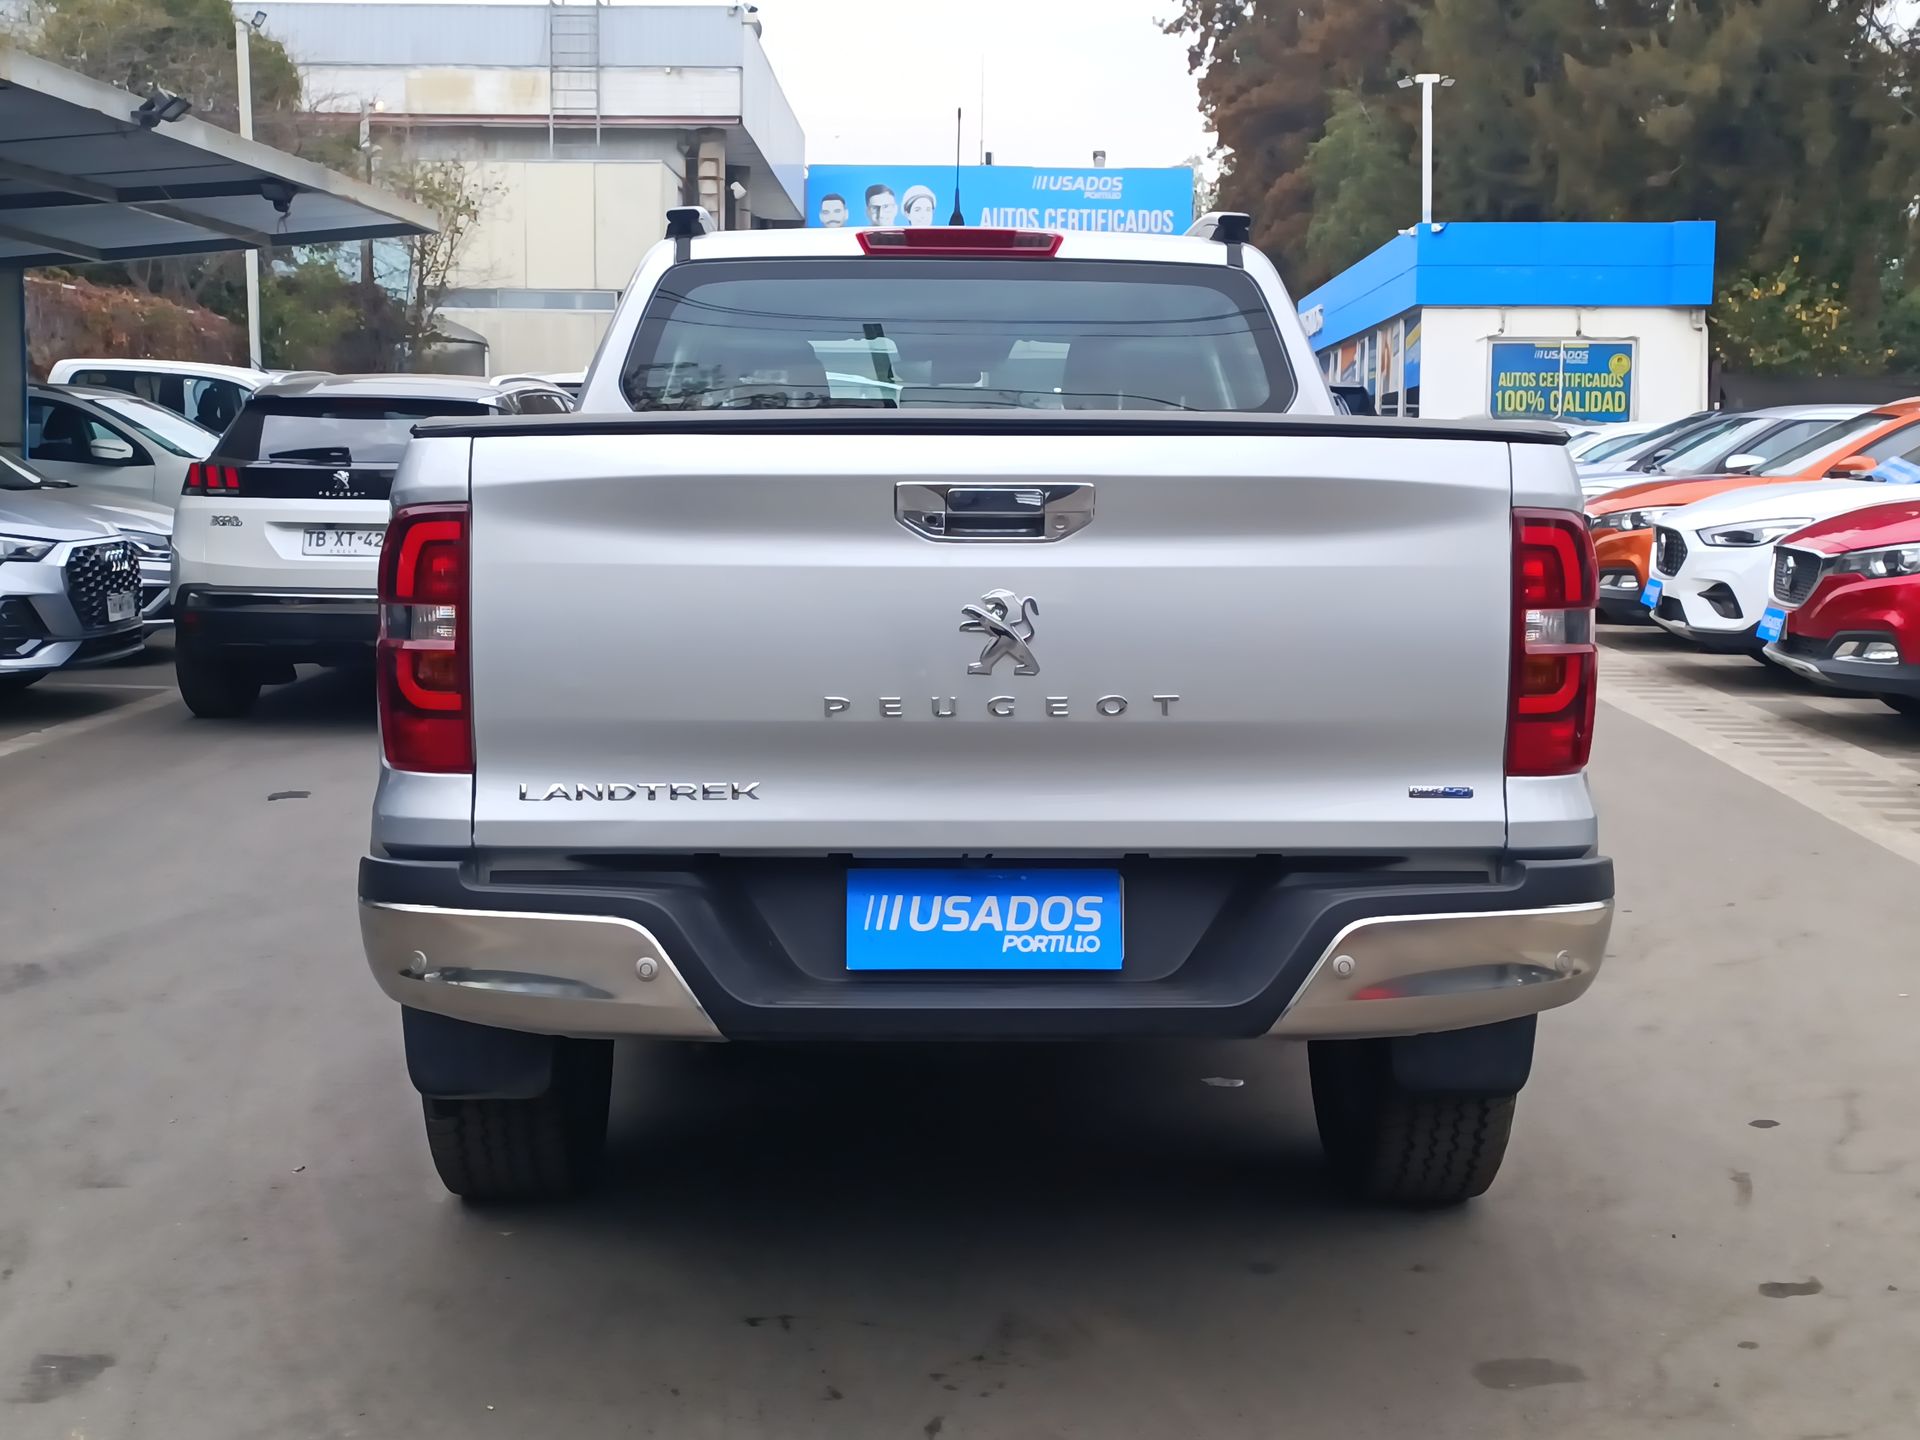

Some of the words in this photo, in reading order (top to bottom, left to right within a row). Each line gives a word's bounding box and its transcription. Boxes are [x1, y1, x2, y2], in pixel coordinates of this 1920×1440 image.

[1049, 175, 1124, 192] USADOS
[980, 207, 1040, 229] AUTOS
[1044, 208, 1174, 233] CERTIFICADOS
[1544, 350, 1589, 360] USADOS
[1498, 372, 1537, 387] AUTOS
[1496, 390, 1545, 412] 100%
[1549, 390, 1626, 413] CALIDAD
[823, 695, 1180, 718] PEUGEOT
[519, 782, 760, 801] LANDTREK
[909, 895, 1104, 932] USADOS
[1002, 934, 1102, 953] PORTILLO
